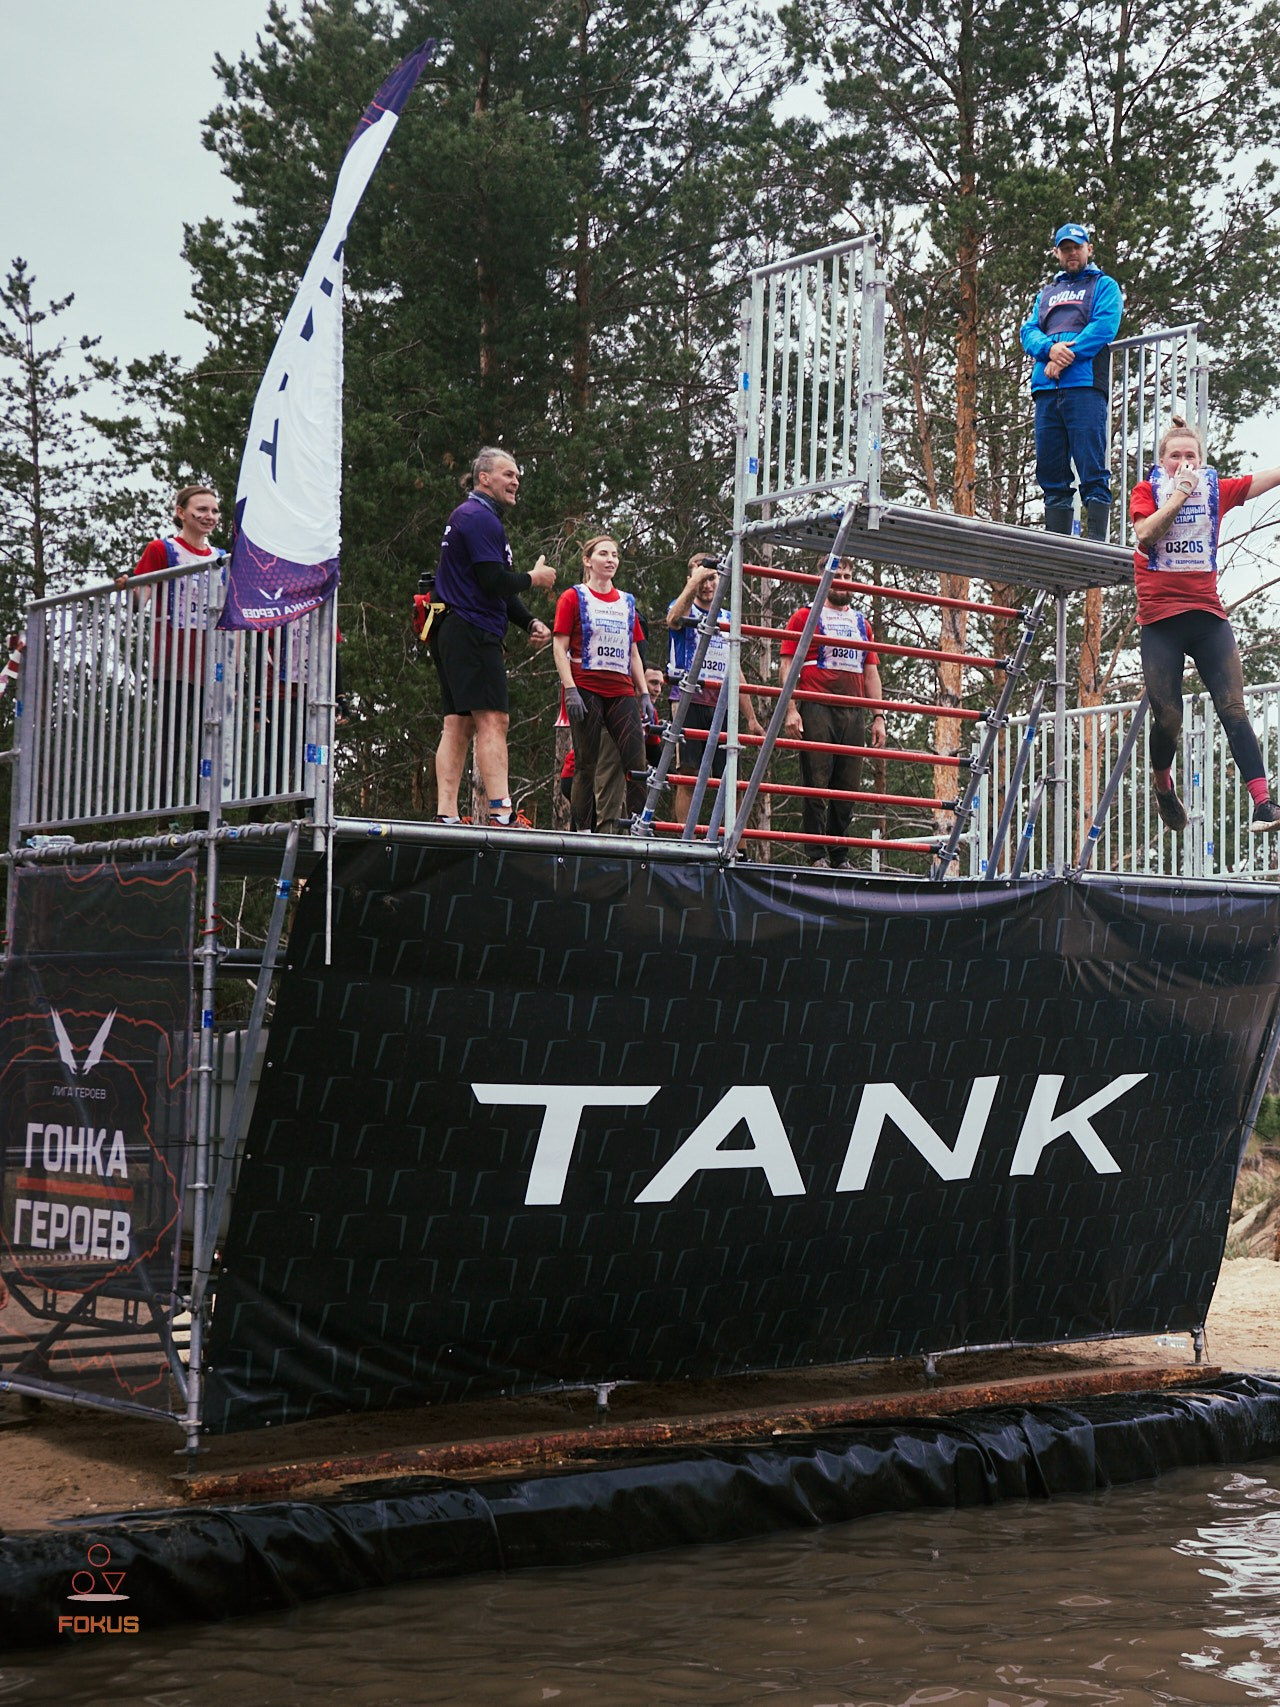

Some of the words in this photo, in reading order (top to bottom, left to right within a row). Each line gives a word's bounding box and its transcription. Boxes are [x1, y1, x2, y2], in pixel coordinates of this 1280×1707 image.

[1048, 289, 1087, 307] СУДЬЯ
[1165, 540, 1204, 554] 03205
[597, 646, 625, 660] 03208
[832, 647, 858, 660] 03201
[52, 1085, 73, 1097] ЛИГА
[74, 1086, 106, 1100] ГЕРОЕВ
[471, 1073, 1149, 1205] TANK
[25, 1122, 128, 1179] ГОНКА
[13, 1198, 131, 1261] ГЕРОЕВ
